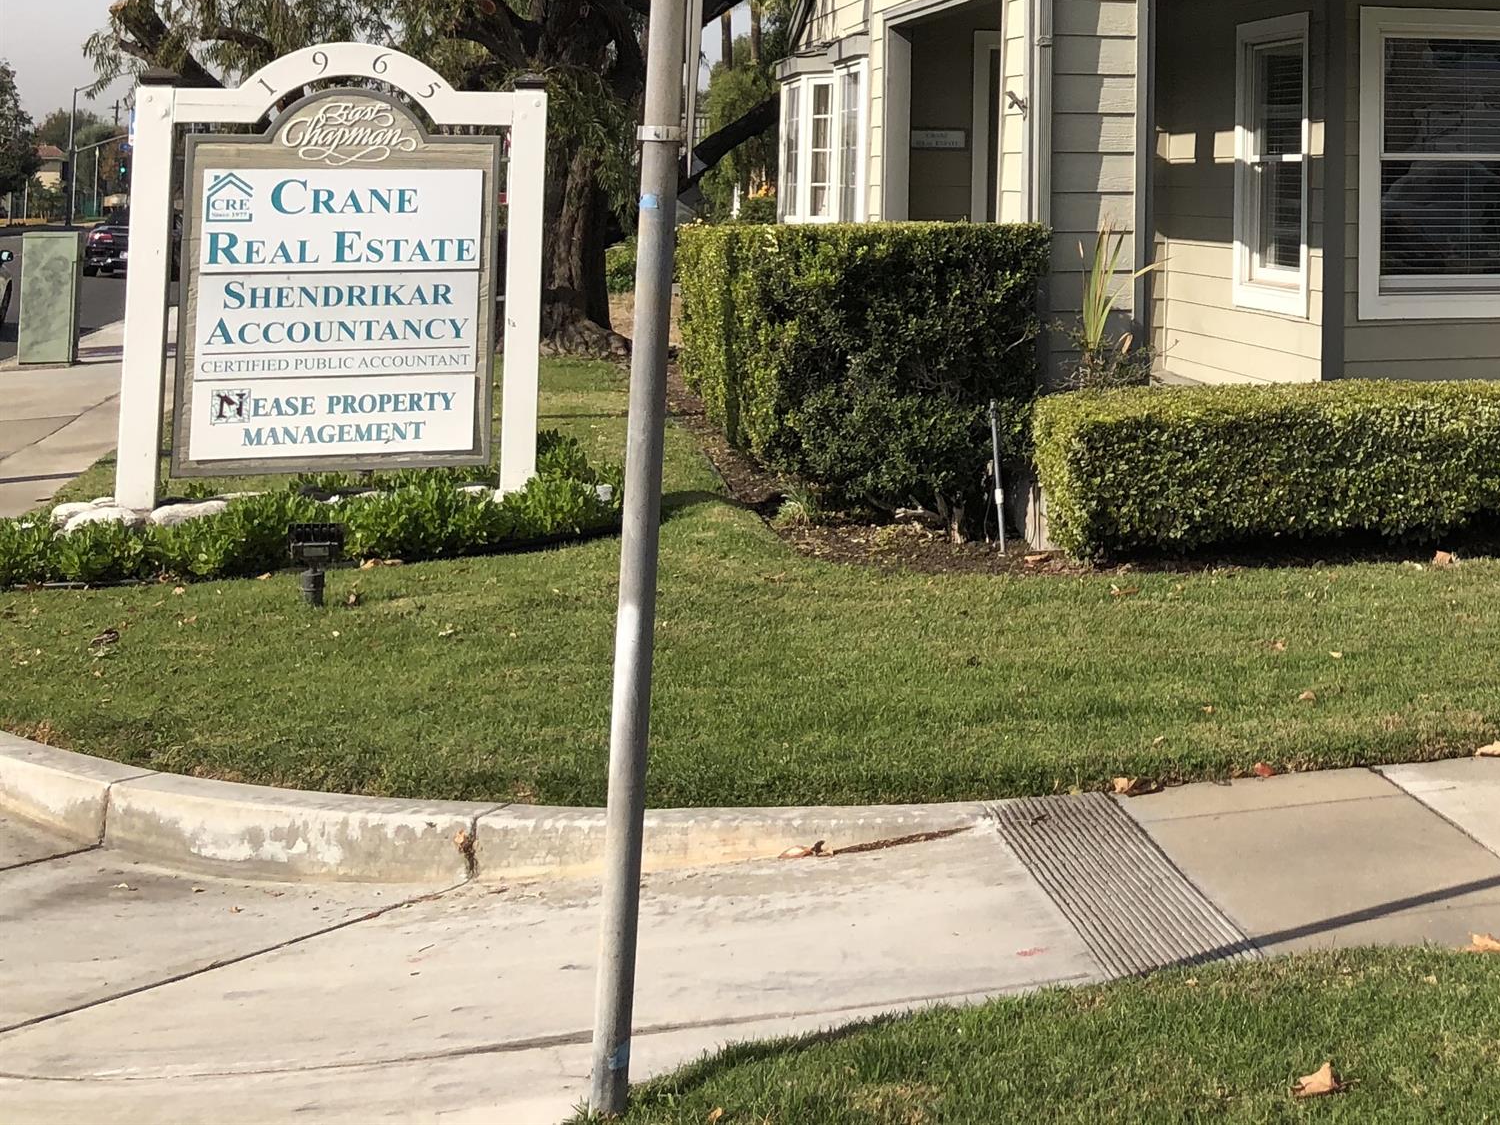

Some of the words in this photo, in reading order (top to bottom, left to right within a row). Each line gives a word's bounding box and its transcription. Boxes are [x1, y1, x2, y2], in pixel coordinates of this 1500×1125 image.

[319, 102, 395, 127] East
[281, 114, 417, 165] Chapman
[211, 198, 250, 211] CRE
[270, 178, 420, 215] CRANE
[204, 231, 320, 265] REAL
[331, 230, 477, 264] ESTATE
[223, 281, 454, 310] SHENDRIKAR
[204, 317, 470, 346] ACCOUNTANCY
[200, 358, 289, 373] CERTIFIED
[294, 356, 354, 371] PUBLIC
[358, 353, 471, 369] ACCOUNTANT
[212, 389, 316, 423] NEASE
[326, 391, 457, 415] PROPERTY
[240, 421, 426, 446] MANAGEMENT
